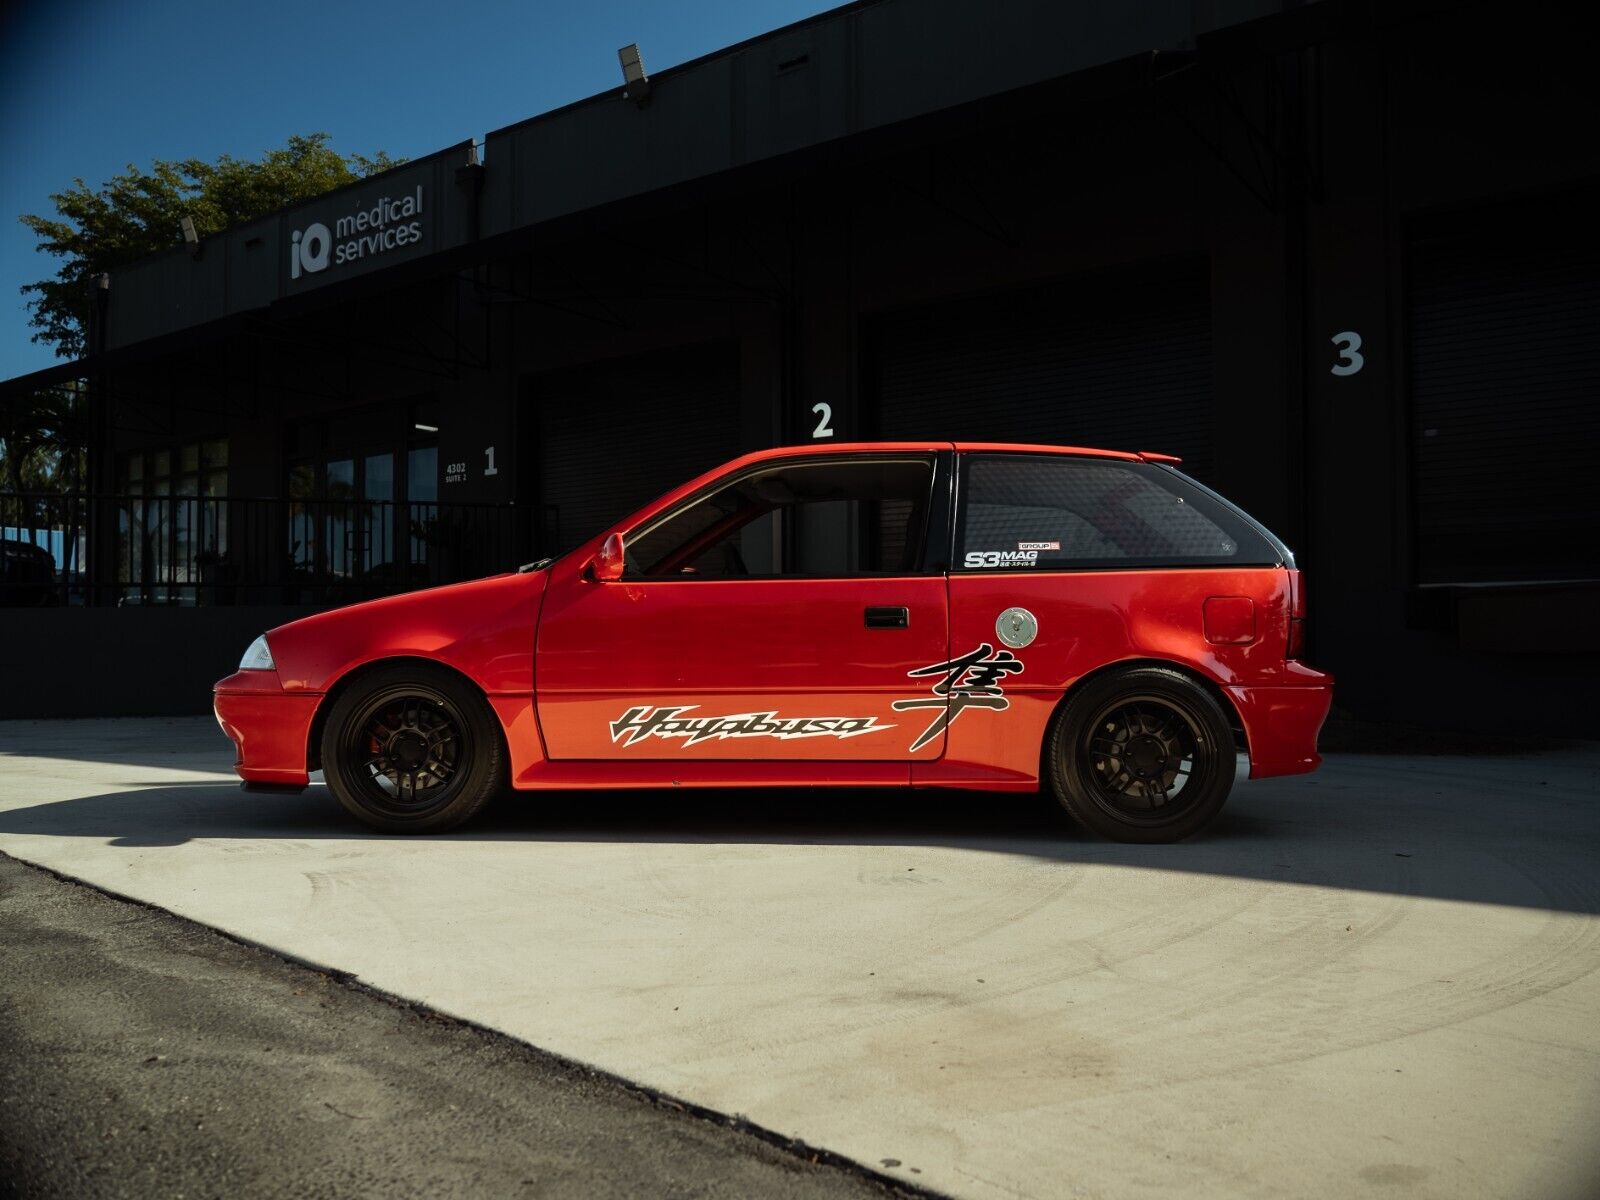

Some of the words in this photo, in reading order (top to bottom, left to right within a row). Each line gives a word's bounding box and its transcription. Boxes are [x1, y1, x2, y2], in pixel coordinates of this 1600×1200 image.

[336, 184, 423, 239] medical
[335, 221, 423, 265] services
[1329, 330, 1366, 377] 3
[811, 402, 835, 440] 2
[445, 474, 462, 483] SUITE
[446, 462, 466, 474] 4302
[483, 446, 498, 476] 1
[608, 705, 898, 749] Hayabusa
